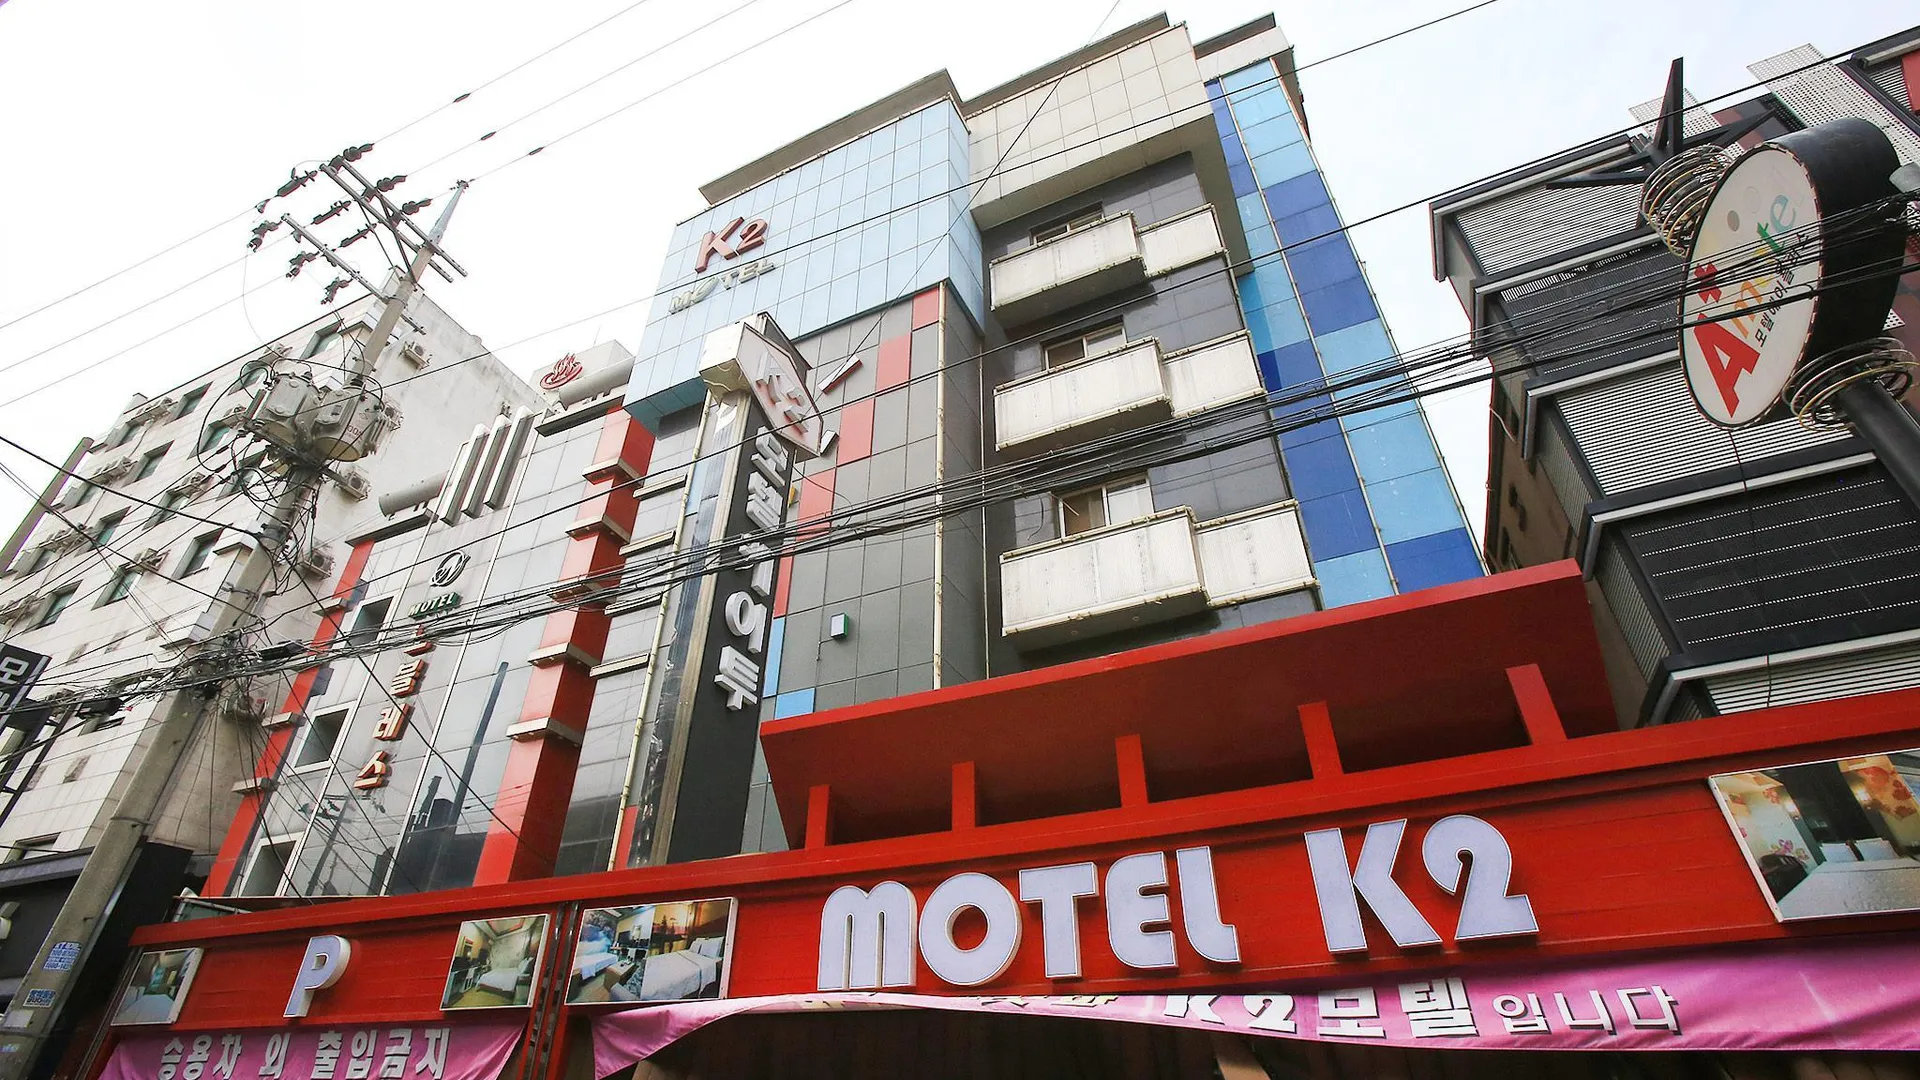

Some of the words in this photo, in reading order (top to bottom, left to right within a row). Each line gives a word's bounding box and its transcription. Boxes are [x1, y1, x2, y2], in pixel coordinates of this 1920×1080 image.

[695, 216, 768, 274] K2
[408, 592, 457, 618] MOTEL
[817, 846, 1242, 992] MOTEL
[1303, 815, 1539, 954] K2
[283, 934, 351, 1017] P
[158, 1033, 242, 1080] 승용차
[258, 1032, 291, 1080] 외
[310, 1027, 450, 1080] 출입금지
